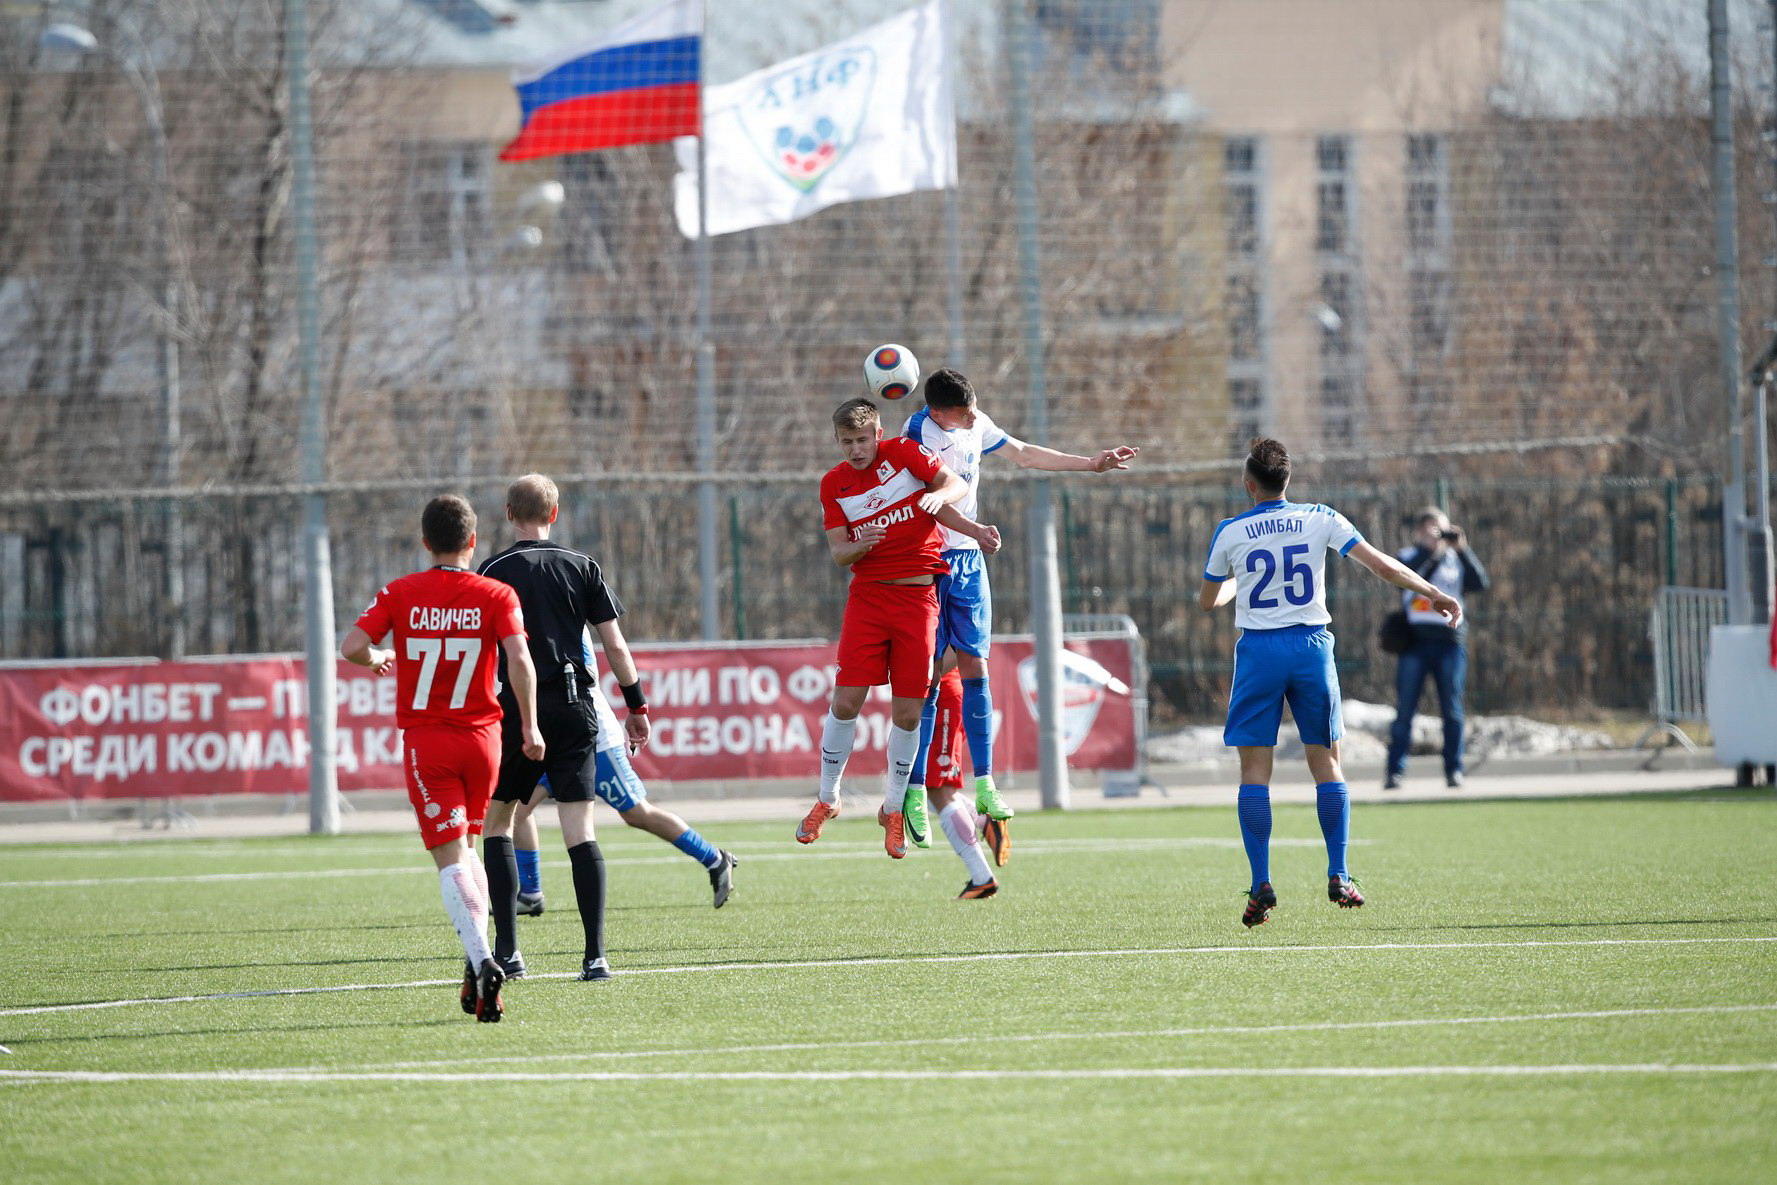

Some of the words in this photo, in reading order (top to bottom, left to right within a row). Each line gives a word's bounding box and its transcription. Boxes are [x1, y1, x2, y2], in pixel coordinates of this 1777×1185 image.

[852, 505, 914, 541] ЛОИЛ
[1245, 518, 1303, 539] ЦИМБАЛ
[1246, 543, 1314, 609] 25
[409, 607, 481, 631] САВИЧЕВ
[40, 682, 223, 726] ФОНБЕТ
[717, 664, 781, 705] ПО
[406, 637, 481, 710] 77
[19, 733, 158, 782] СРЕДИ
[649, 712, 813, 757] СЕЗОНА
[599, 775, 627, 802] 21
